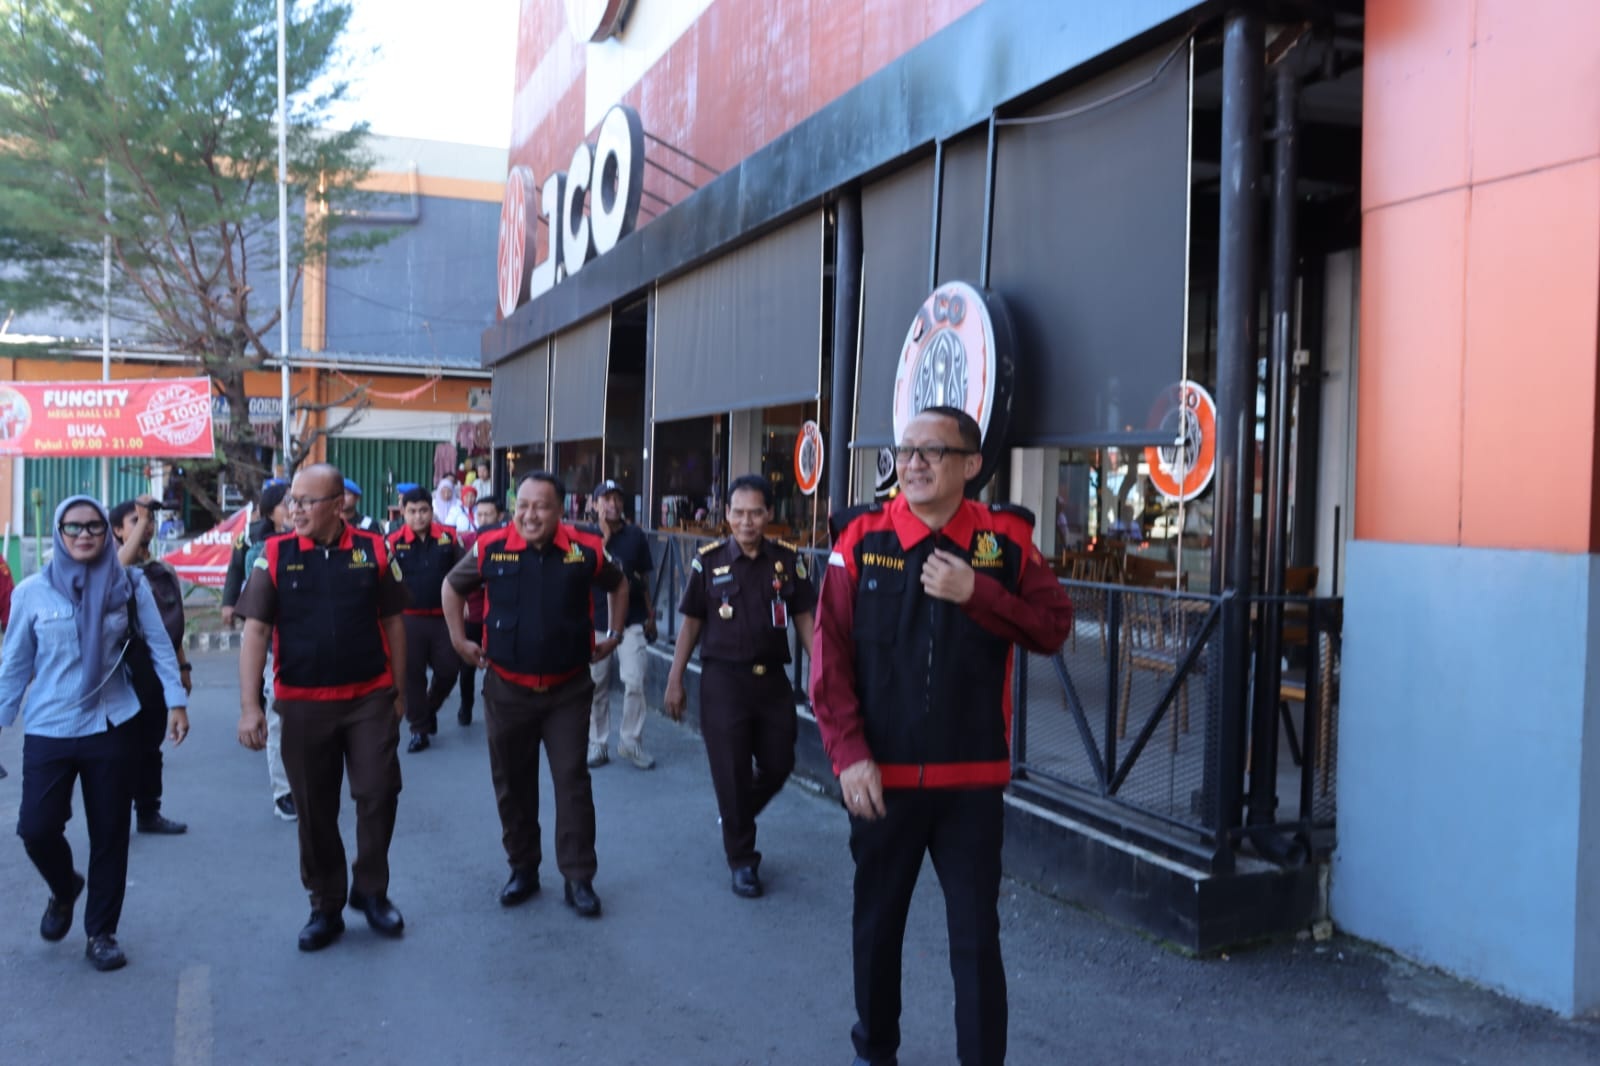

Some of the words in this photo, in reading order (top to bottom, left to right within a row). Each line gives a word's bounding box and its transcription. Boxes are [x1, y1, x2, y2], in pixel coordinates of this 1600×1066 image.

[43, 388, 129, 408] FUNCITY
[47, 408, 74, 419] MEGA
[76, 408, 101, 419] MALL
[67, 423, 107, 438] BUKA
[34, 438, 62, 451] Pukul
[71, 437, 103, 449] 09.00
[111, 437, 144, 449] 21.00
